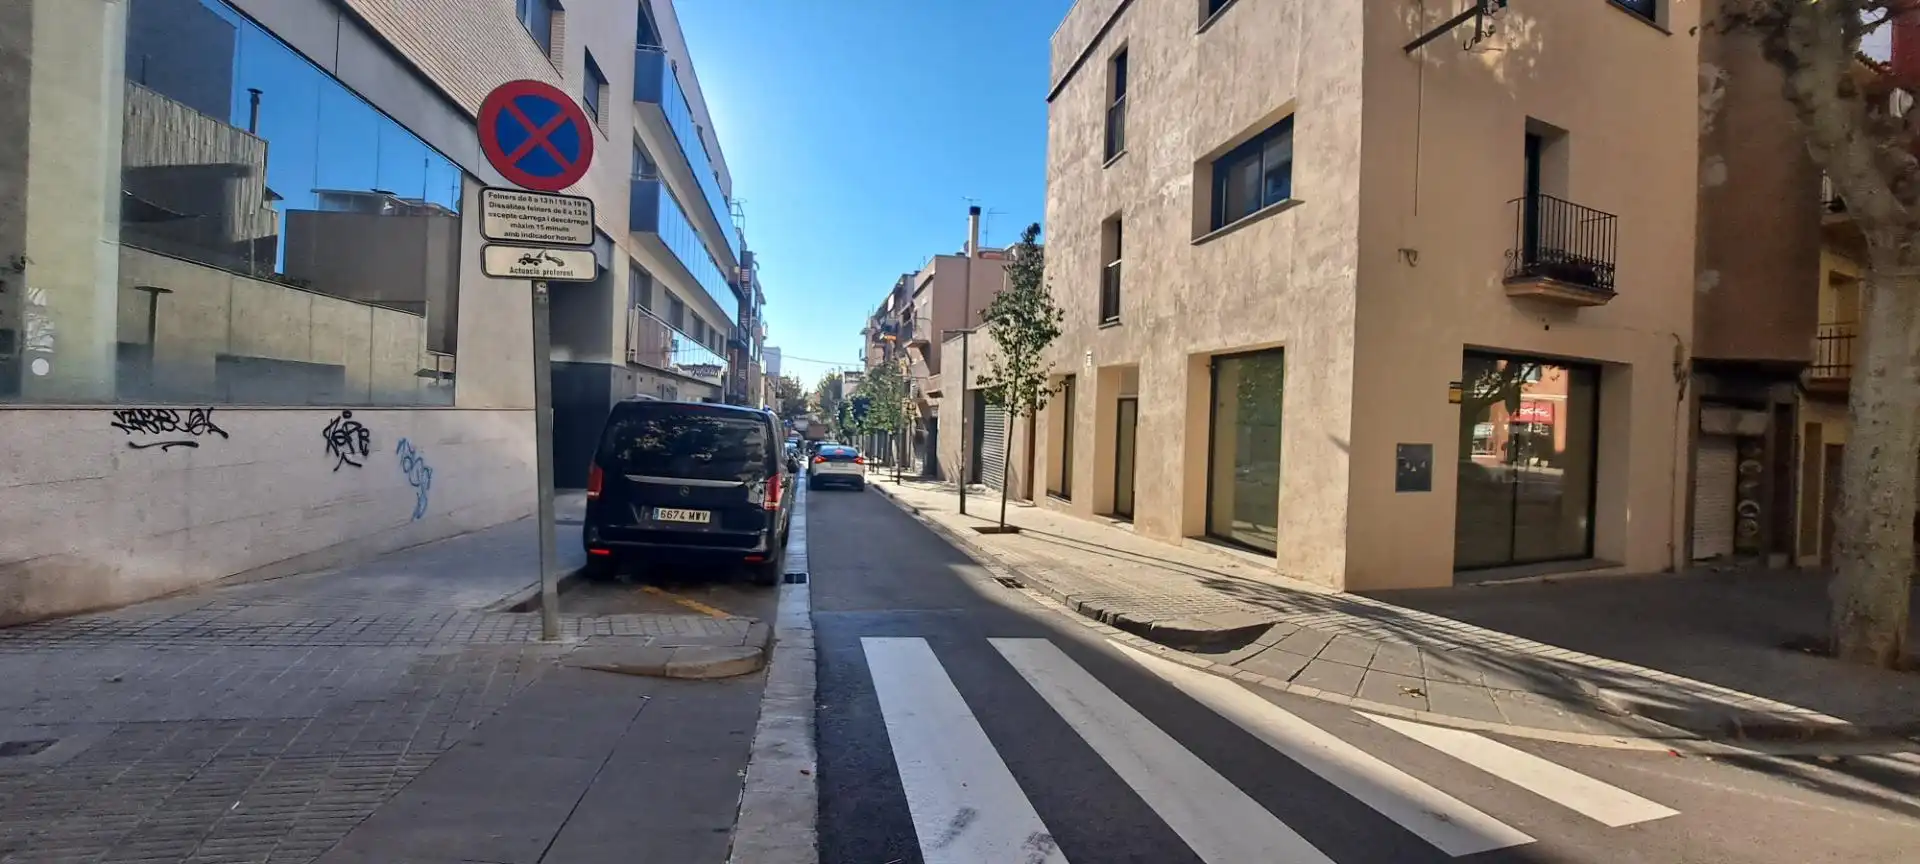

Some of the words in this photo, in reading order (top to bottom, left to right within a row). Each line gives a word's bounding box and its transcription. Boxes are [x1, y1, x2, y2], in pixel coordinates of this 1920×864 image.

[488, 192, 516, 200] Feiners
[521, 231, 554, 240] indicador
[660, 510, 685, 520] 6674
